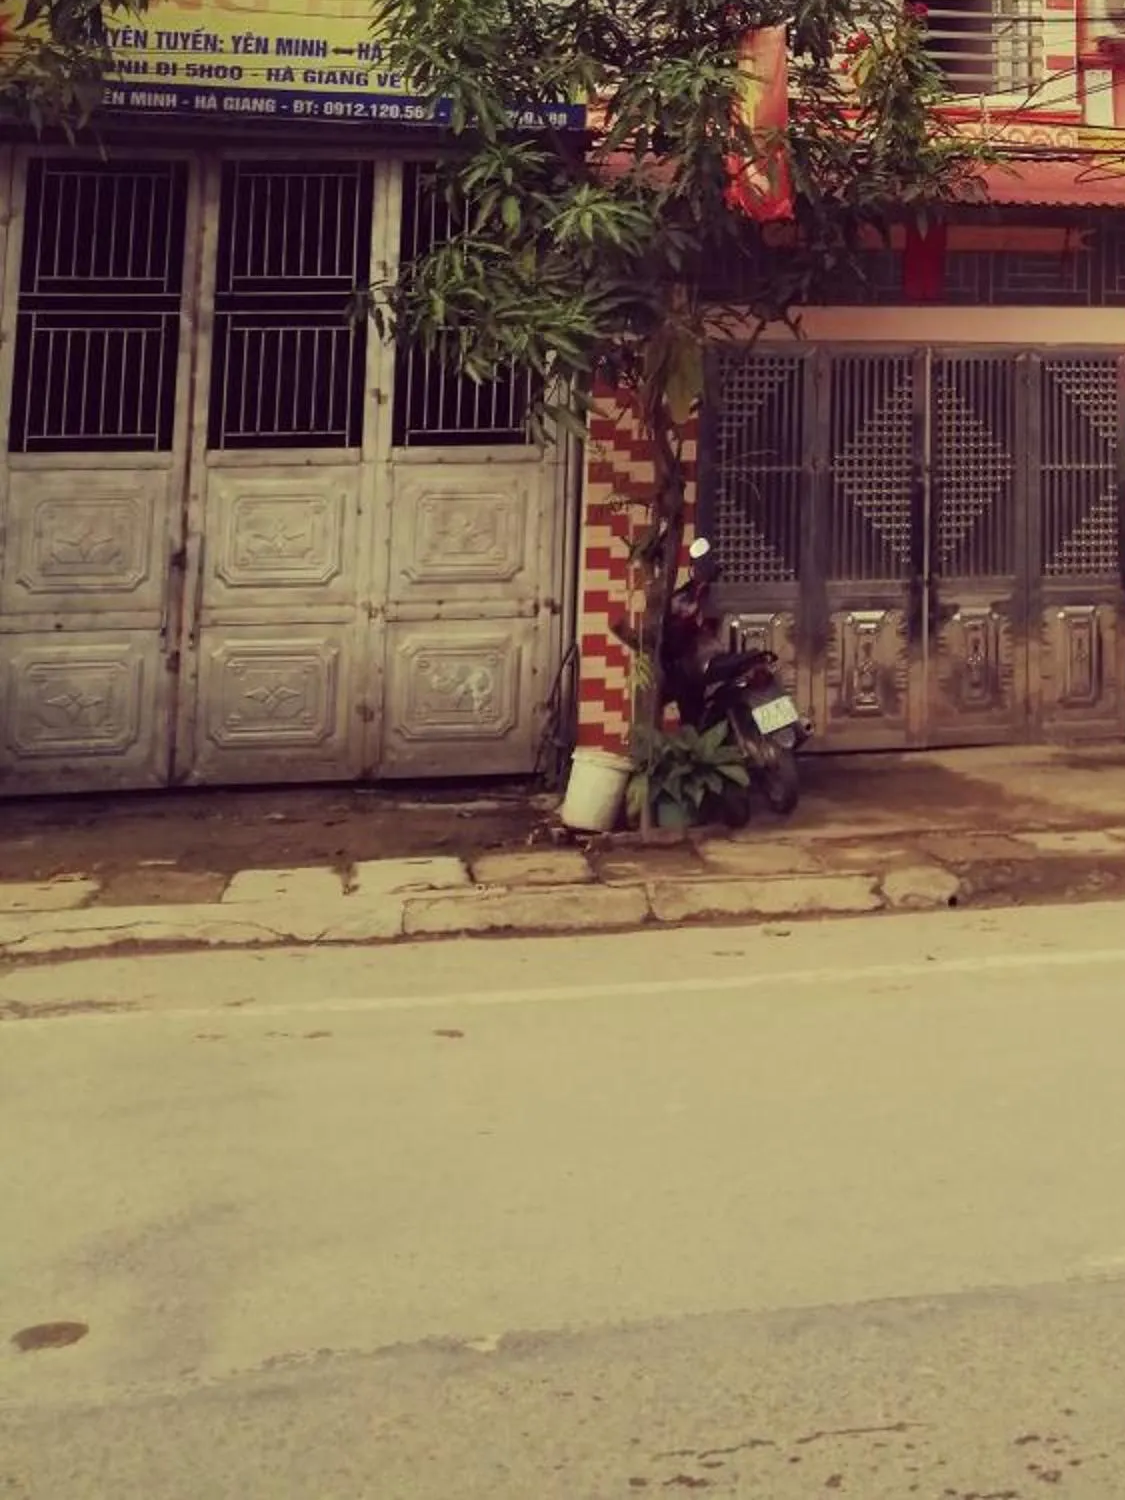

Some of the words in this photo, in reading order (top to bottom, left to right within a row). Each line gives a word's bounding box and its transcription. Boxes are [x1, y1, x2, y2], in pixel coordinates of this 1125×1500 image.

[155, 26, 224, 52] TUYẾN:
[231, 31, 269, 55] YÊN
[275, 37, 328, 58] MINH
[265, 65, 295, 83] HÀ
[303, 68, 369, 87] GIANG
[103, 88, 125, 105] ÊN
[130, 92, 177, 108] MINH
[195, 94, 217, 110] HÀ
[223, 97, 276, 113] GIANG
[323, 101, 434, 120] 0912.120.56
